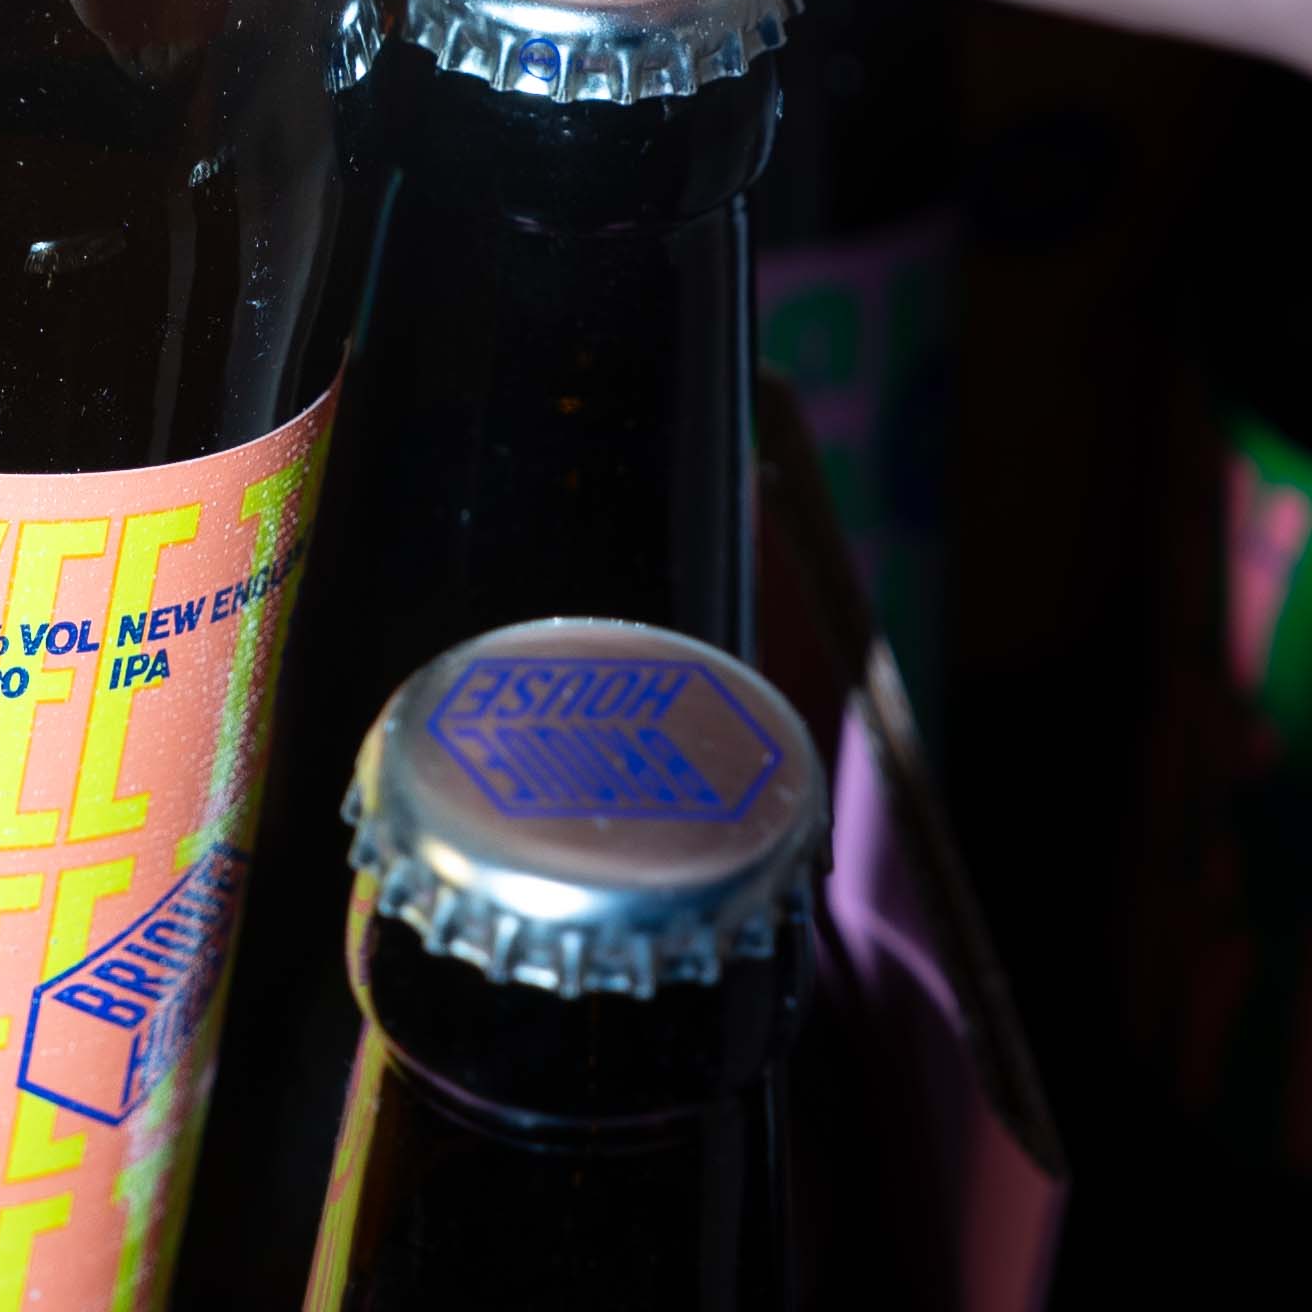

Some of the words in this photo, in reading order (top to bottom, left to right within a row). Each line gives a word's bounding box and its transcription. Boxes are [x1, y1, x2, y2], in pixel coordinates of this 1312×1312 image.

[19, 618, 101, 658] VOL
[116, 595, 208, 649] NEW
[108, 648, 172, 691] IPA
